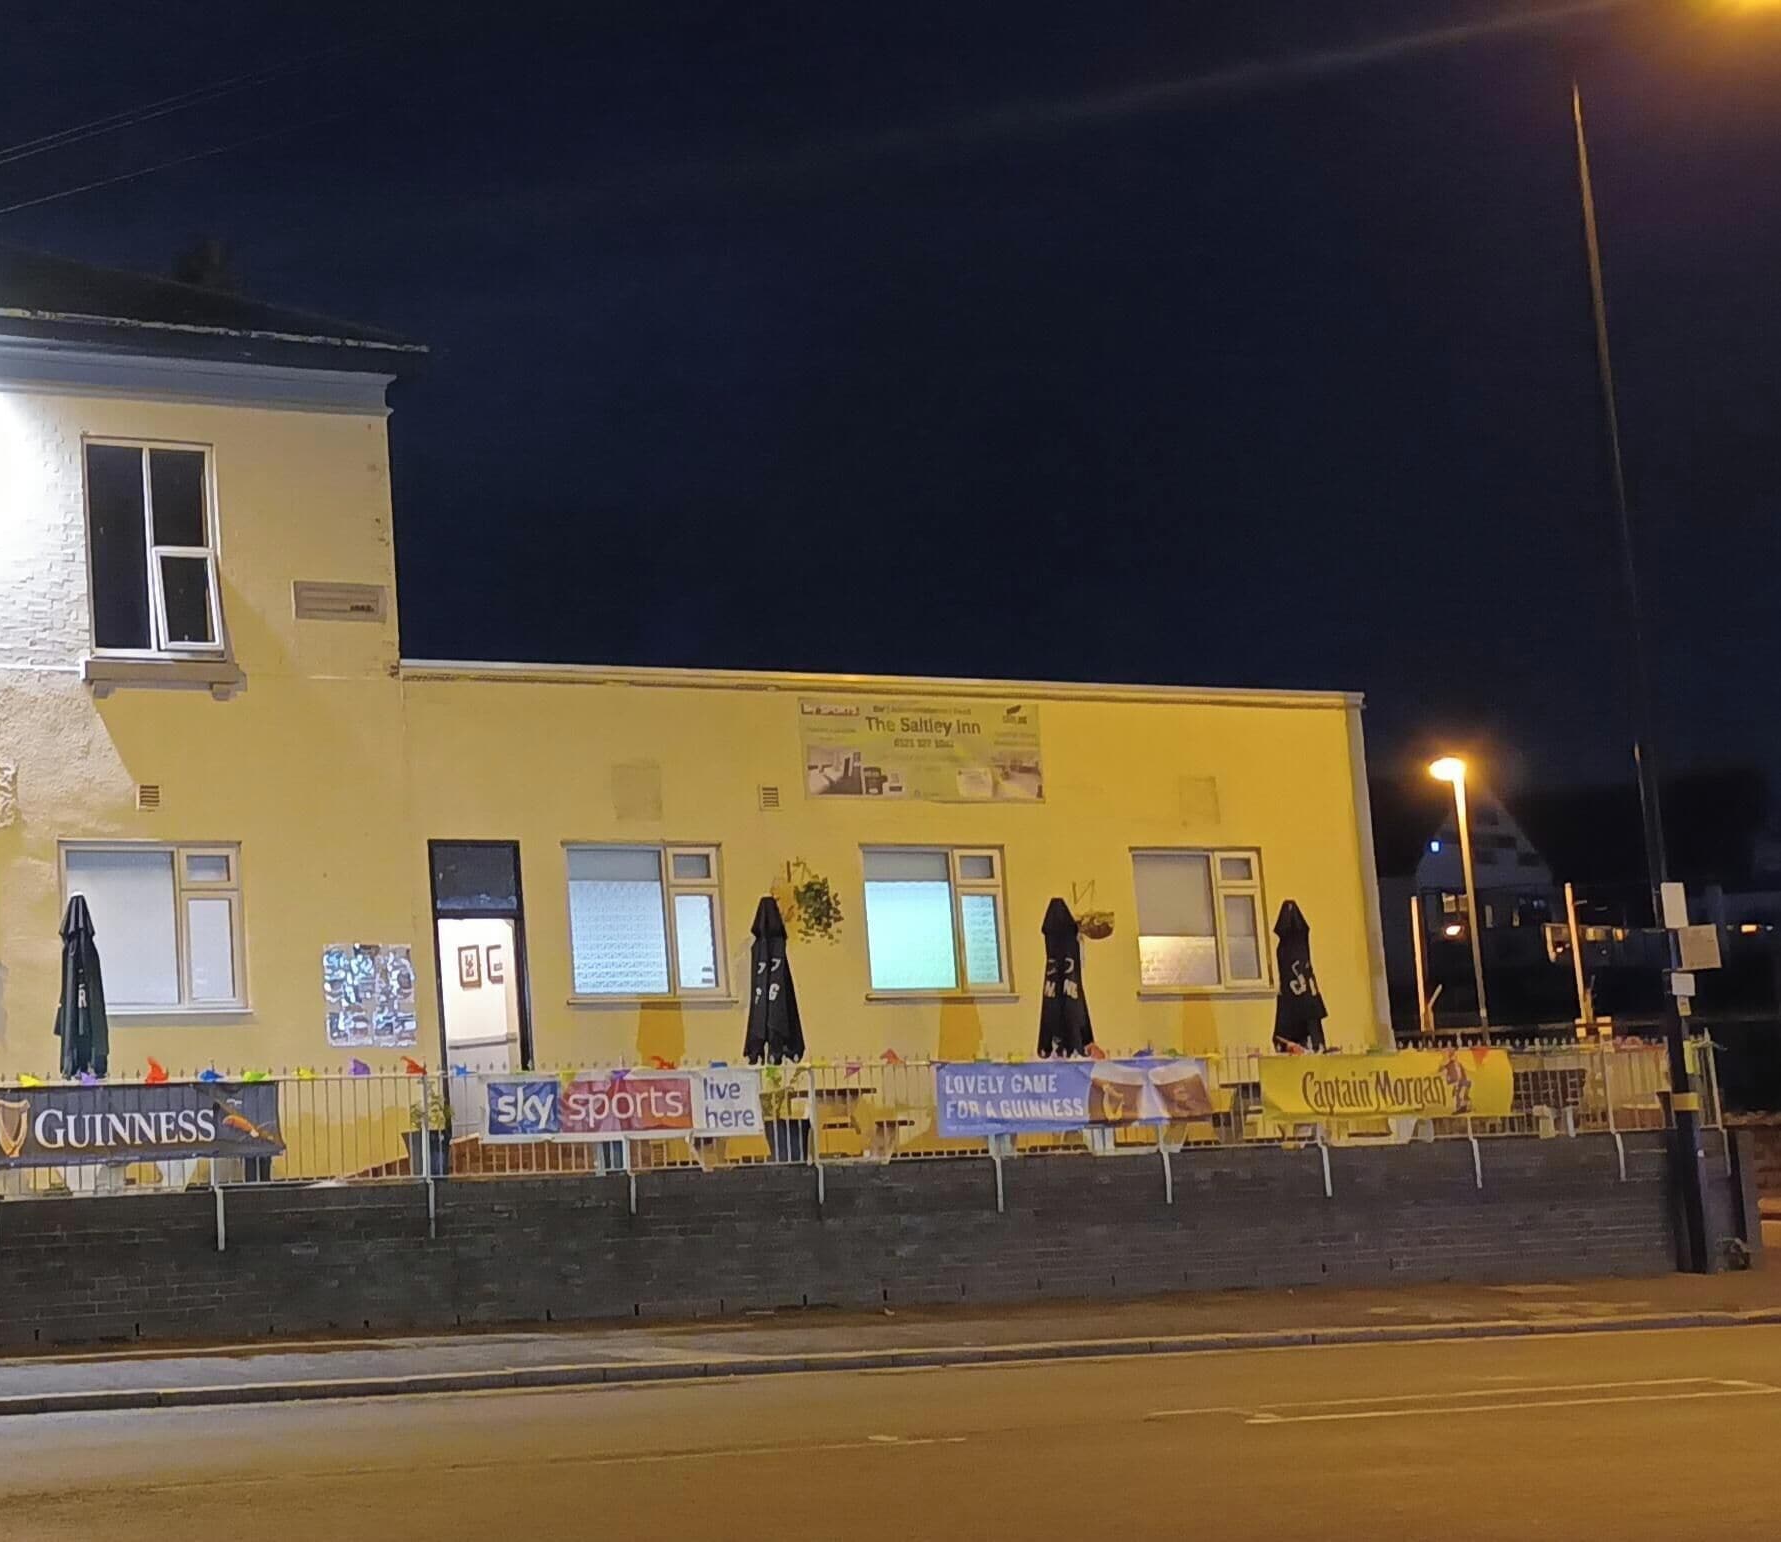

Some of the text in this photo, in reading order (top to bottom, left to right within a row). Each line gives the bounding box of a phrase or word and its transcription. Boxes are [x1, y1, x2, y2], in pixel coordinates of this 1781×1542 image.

[865, 716, 895, 732] The
[956, 720, 982, 735] Inn
[703, 1077, 741, 1101] live
[944, 1073, 1058, 1095] LOVELY GAME
[1301, 1070, 1447, 1116] Captain Morgan
[497, 1086, 685, 1130] sky sports
[705, 1105, 757, 1130] here
[946, 1100, 980, 1120] FOR
[999, 1097, 1084, 1119] GUINNESS
[34, 1108, 218, 1149] GUINNESS
